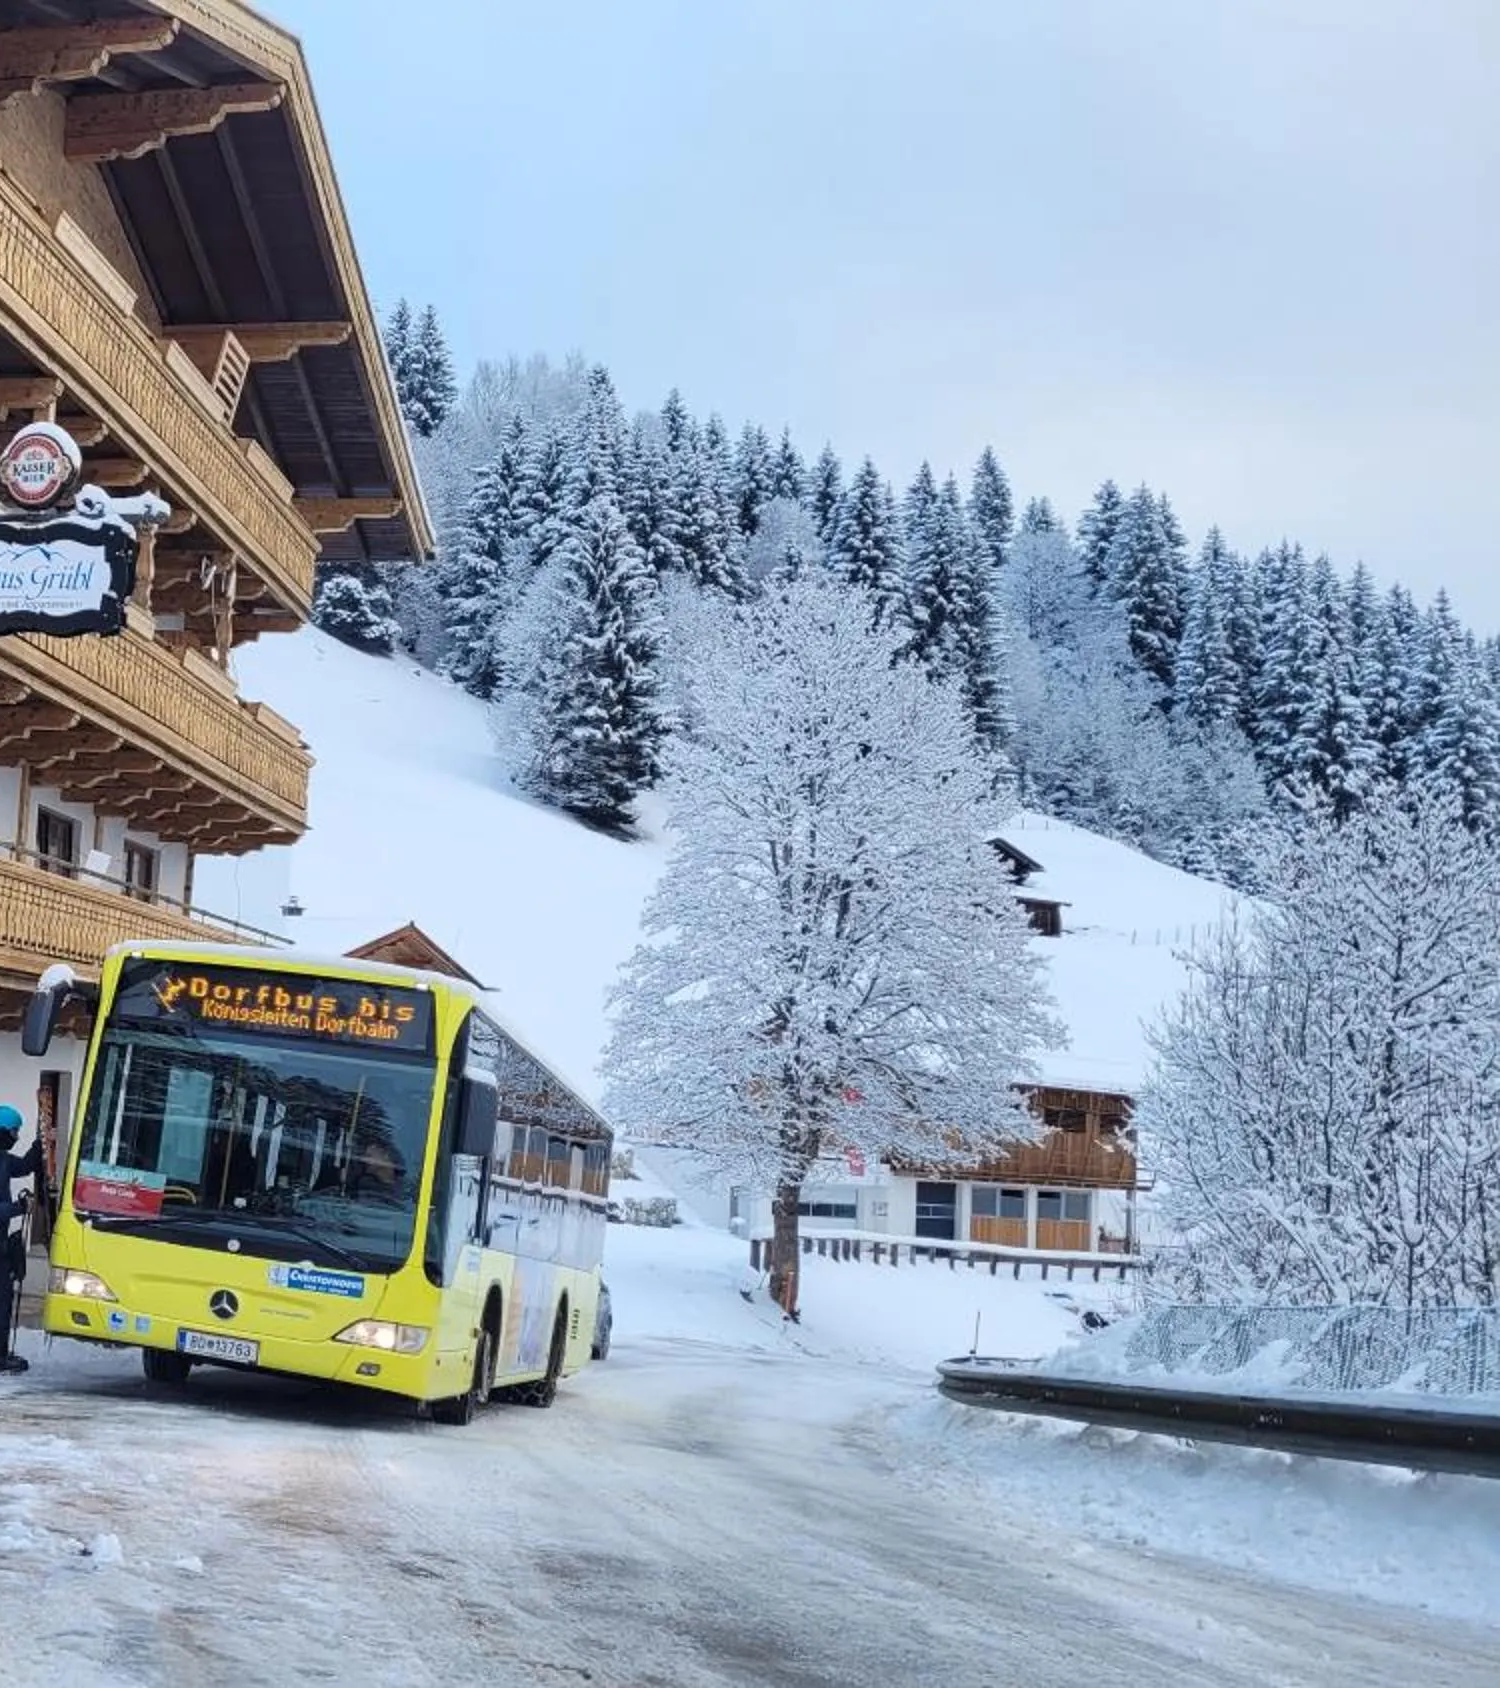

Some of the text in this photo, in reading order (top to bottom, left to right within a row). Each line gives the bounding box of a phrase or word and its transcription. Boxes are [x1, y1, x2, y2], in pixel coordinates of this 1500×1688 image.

[12, 461, 56, 477] KAISER
[25, 560, 96, 601] Grübl
[189, 976, 416, 1022] Dorfbus bis
[201, 998, 399, 1040] Königsleiten Dorfbahn
